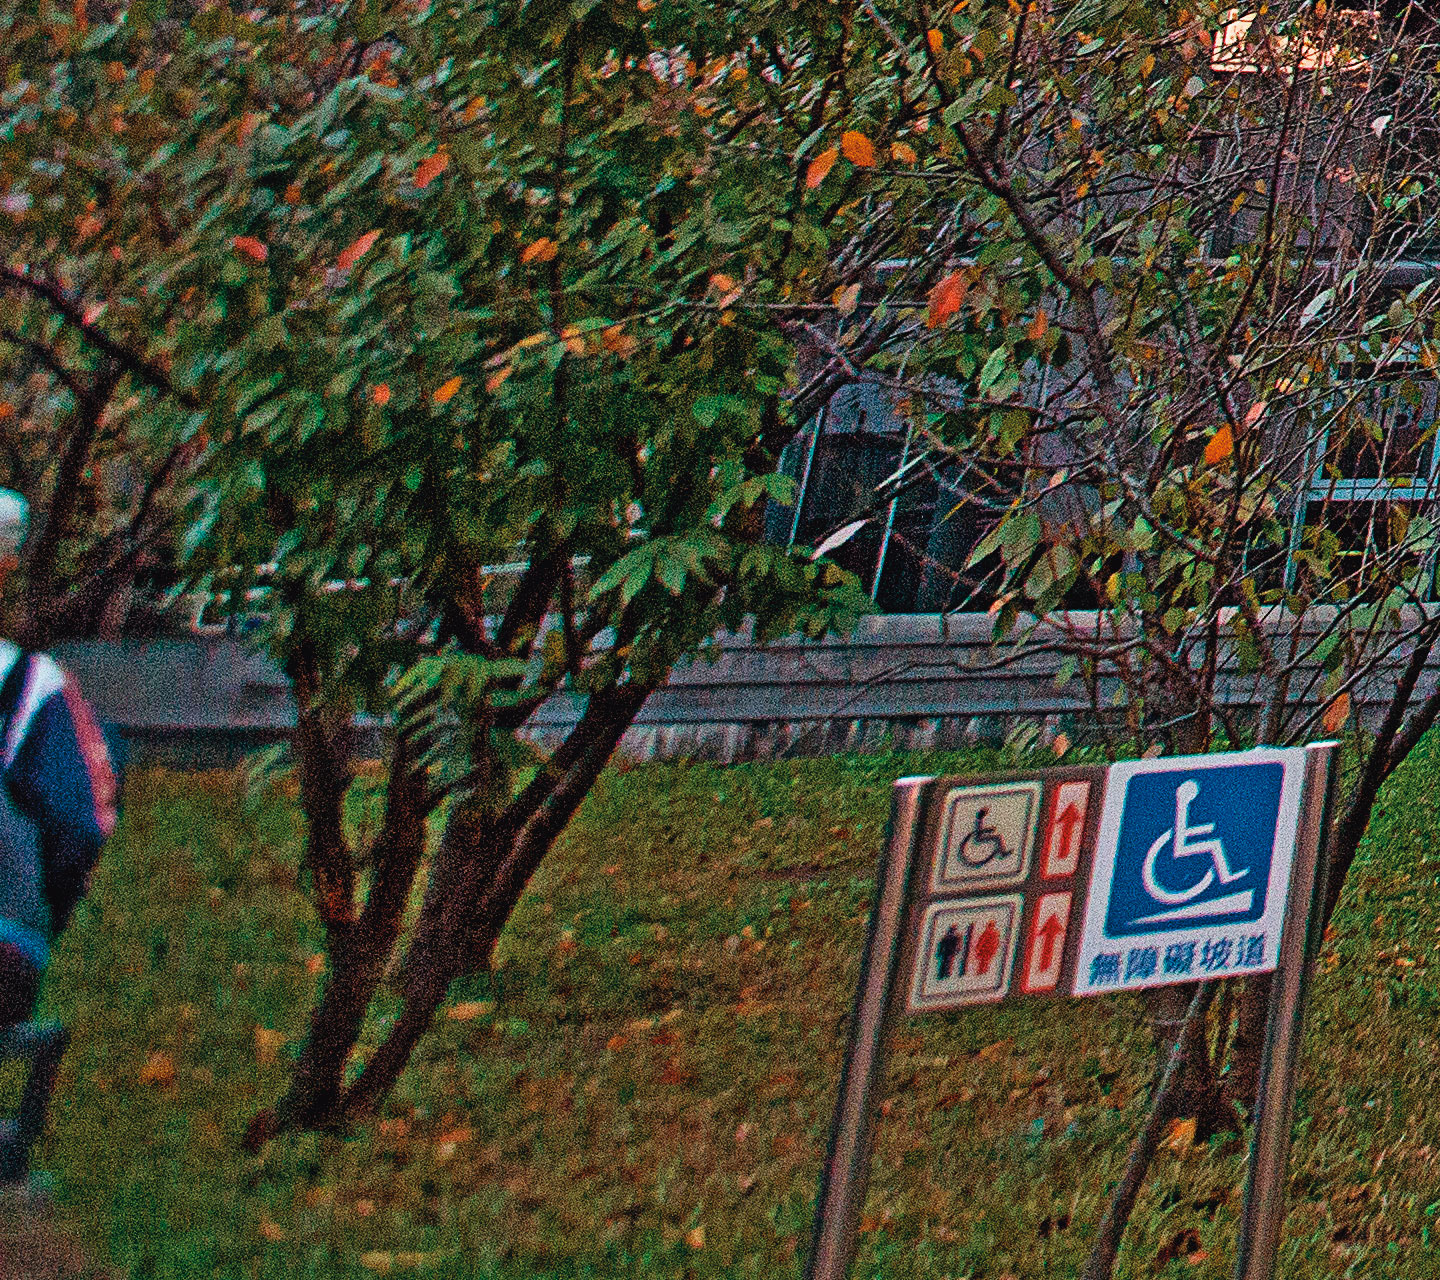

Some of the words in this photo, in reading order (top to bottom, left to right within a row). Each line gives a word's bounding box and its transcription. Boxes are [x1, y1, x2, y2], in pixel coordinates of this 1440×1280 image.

[1089, 933, 1266, 986] 無障礙坡道
